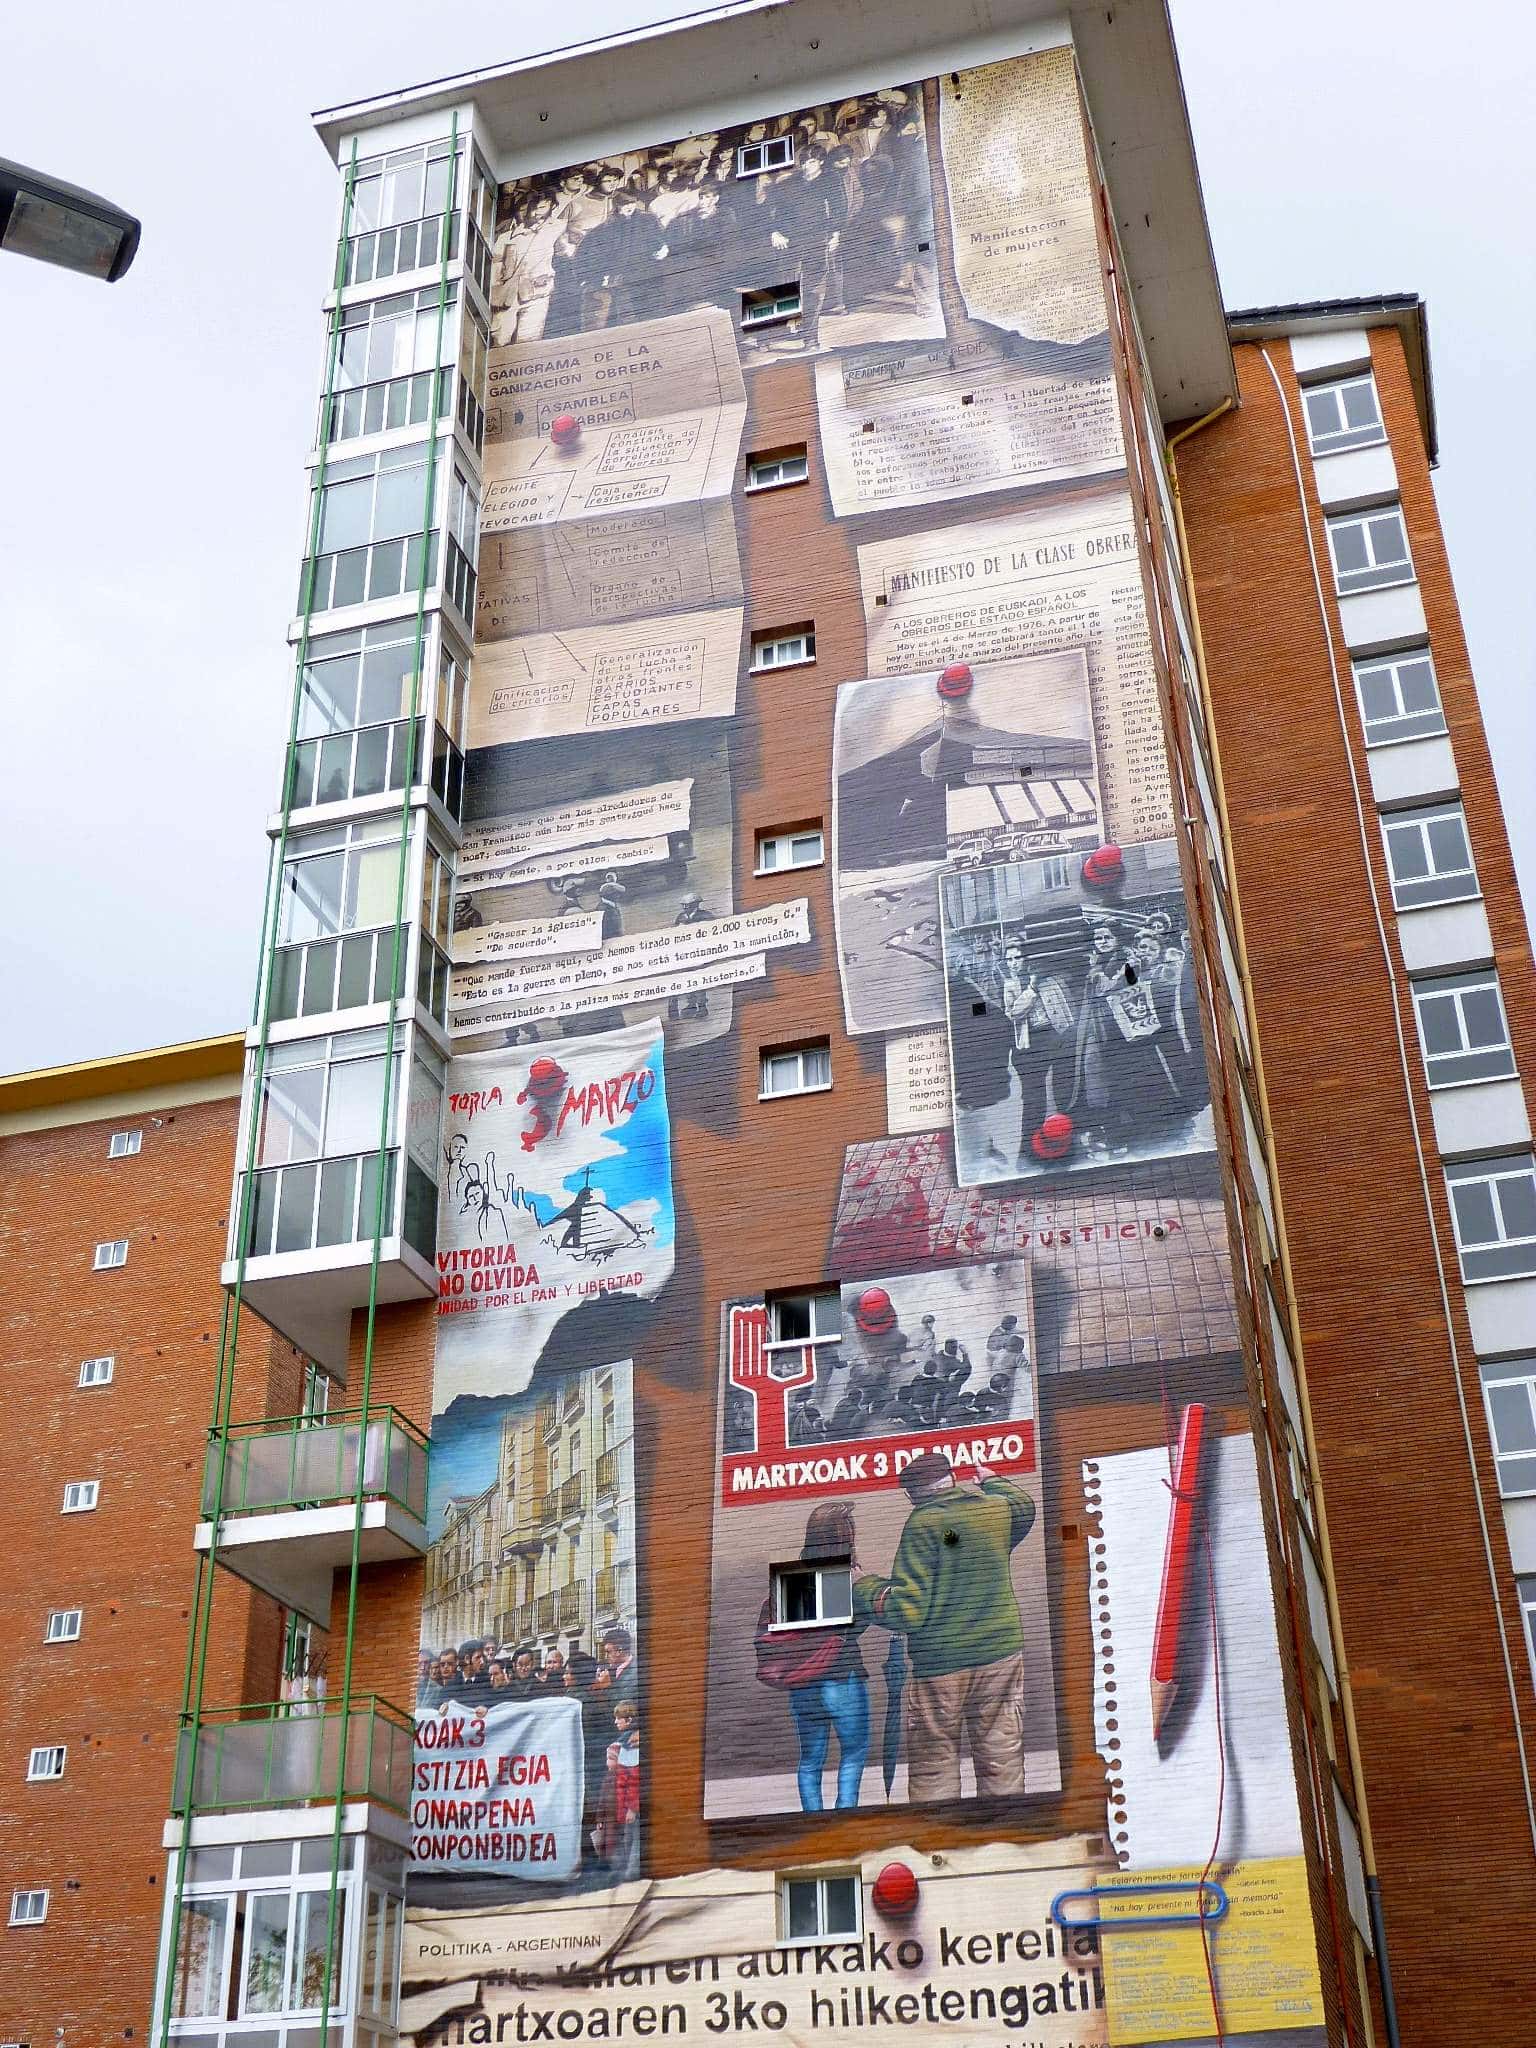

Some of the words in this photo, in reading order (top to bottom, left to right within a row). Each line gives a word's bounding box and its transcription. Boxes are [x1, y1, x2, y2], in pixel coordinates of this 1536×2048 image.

[984, 246, 1000, 257] de
[1005, 236, 1060, 254] mujeres
[594, 351, 614, 362] DE
[628, 345, 650, 357] LA
[595, 360, 663, 380] OBRERA
[541, 390, 630, 414] ASAMBLEA
[575, 407, 633, 426] ABRICA
[490, 481, 538, 496] COMITE
[483, 497, 538, 513] ELEGIDO
[891, 561, 975, 593] MANIFIESTO
[984, 557, 1001, 574] DE
[1012, 552, 1029, 569] LA
[1035, 543, 1076, 566] CLASE
[491, 615, 508, 627] DE
[893, 622, 901, 631] A
[903, 617, 923, 628] LOS
[925, 609, 977, 625] OBREROS
[980, 606, 995, 616] DE
[1054, 594, 1063, 602] A
[1066, 589, 1087, 600] LOS
[901, 622, 951, 638] OBREROS
[954, 618, 976, 629] DEL
[979, 610, 1025, 625] ESTADO
[968, 629, 998, 640] Marzo
[1049, 617, 1057, 625] A
[1059, 612, 1085, 624] partir
[594, 680, 693, 704] ESTUDIANTES
[595, 676, 656, 694] BARRIOS
[592, 704, 680, 724] POPULARES
[593, 698, 641, 713] CAPAS
[576, 808, 593, 817] los
[556, 860, 575, 872] por
[586, 953, 604, 963] que
[607, 945, 635, 957] hemos
[639, 936, 670, 950] tirado
[695, 928, 709, 939] de
[711, 920, 741, 936] 2.000
[745, 914, 779, 929] tiros,
[491, 986, 503, 995] es
[507, 983, 520, 993] la
[523, 977, 556, 993] guerra
[574, 969, 607, 985] pleno,
[733, 940, 746, 950] la
[454, 1013, 482, 1028] hemos
[560, 1000, 572, 1010] la
[575, 994, 609, 1009] paliza
[633, 985, 667, 999] grande
[670, 982, 682, 991] de
[686, 978, 698, 988] la
[556, 1070, 656, 1137] MARZO
[437, 1244, 517, 1272] VITORIA
[439, 1273, 465, 1297] NO
[470, 1264, 540, 1293] OLVIDA
[485, 1294, 509, 1309] POR
[514, 1292, 527, 1305] EL
[531, 1287, 557, 1302] PAN
[564, 1284, 574, 1296] Y
[577, 1271, 643, 1295] LIBERTAD
[732, 1453, 867, 1492] MARTXOAK
[873, 1455, 888, 1477] 3
[468, 1718, 486, 1748] 3
[411, 1758, 490, 1792] STIZIA
[497, 1754, 551, 1786] EGIA
[414, 1797, 536, 1830] ONARPENA
[418, 1942, 493, 1958] POLITIKA
[506, 1934, 601, 1953] ARGENTINAN
[736, 1932, 924, 1978] aurkako
[704, 1989, 788, 2032] 3ko
